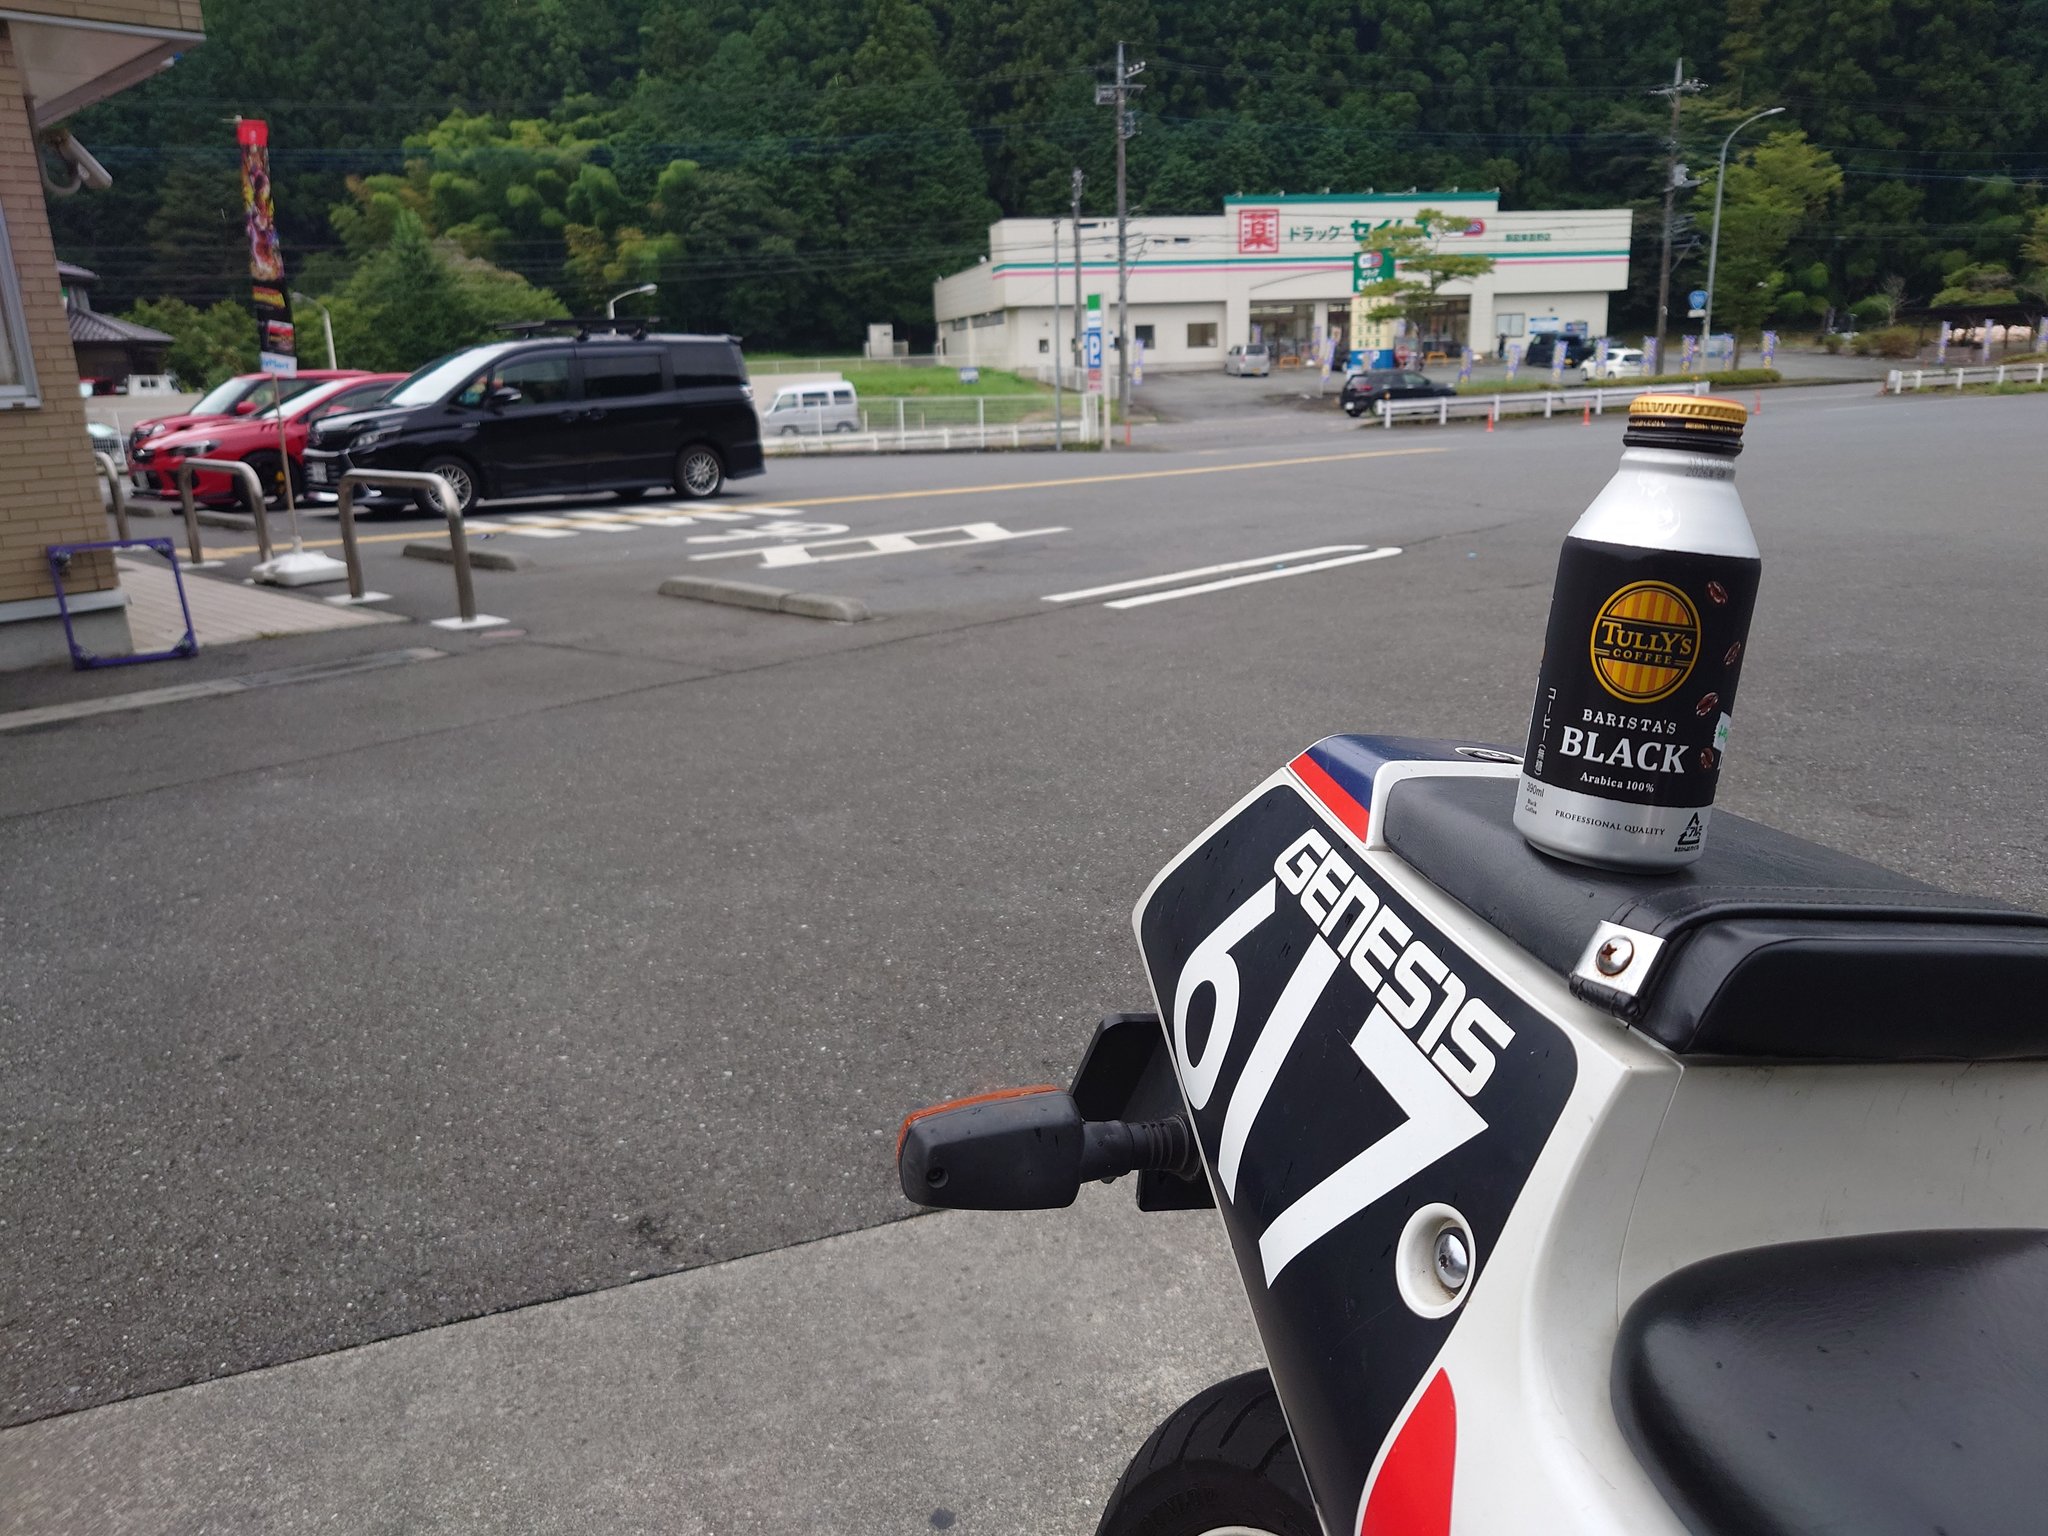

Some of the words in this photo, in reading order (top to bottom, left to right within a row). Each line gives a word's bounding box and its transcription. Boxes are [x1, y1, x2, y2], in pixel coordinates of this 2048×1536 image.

[1243, 212, 1276, 250] 薬
[1289, 225, 1341, 241] ドラッグ
[1601, 620, 1692, 656] TULLY'S
[1612, 647, 1673, 665] COFFEE
[1582, 708, 1677, 735] BARISTA'S
[1559, 725, 1690, 774] BLACK
[1526, 781, 1545, 798] 390ml
[1580, 772, 1623, 789] Arabica
[1626, 780, 1654, 793] 100%
[1555, 809, 1622, 831] PROFESSIONAL
[1624, 824, 1666, 836] QUALITY
[1273, 828, 1516, 1097] GENESIS
